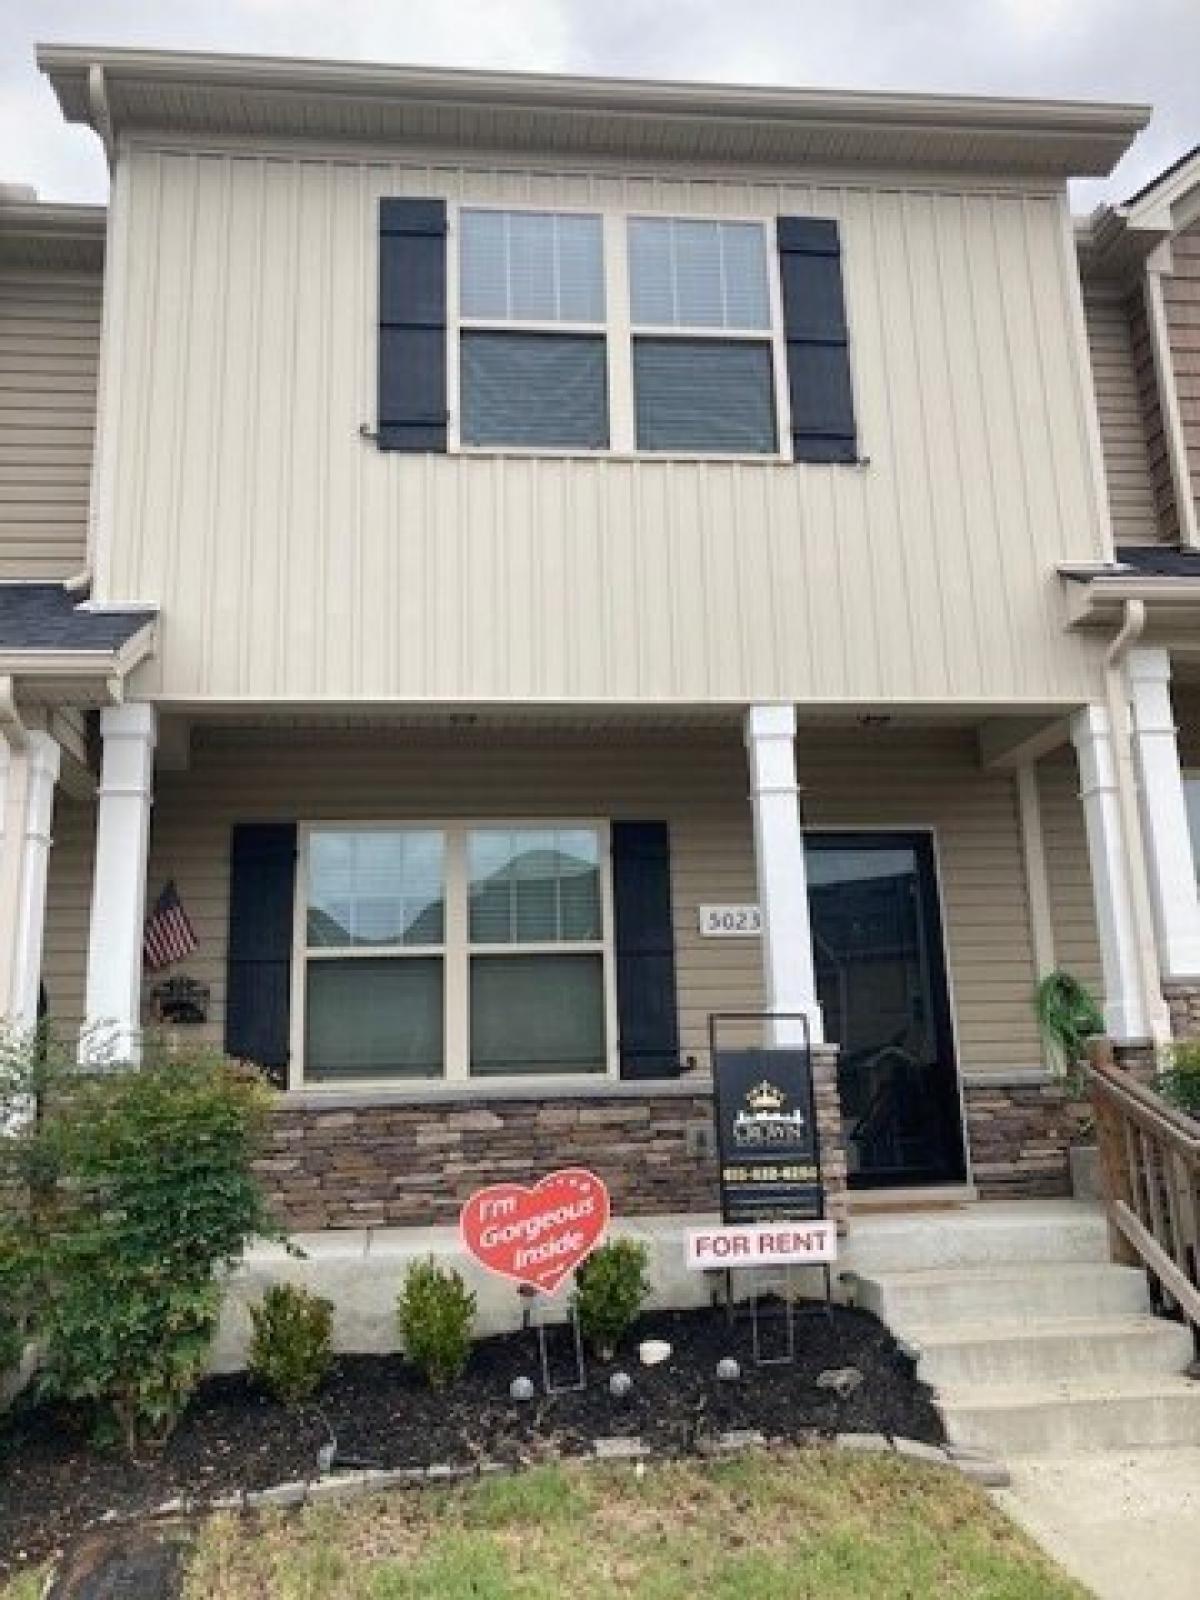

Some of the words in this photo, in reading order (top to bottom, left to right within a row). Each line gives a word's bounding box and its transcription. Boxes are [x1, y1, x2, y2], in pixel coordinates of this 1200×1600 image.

[479, 1197, 595, 1248] Gorgeous
[512, 1229, 584, 1271] Inside
[696, 1236, 751, 1258] FOR
[759, 1230, 828, 1255] RENT
